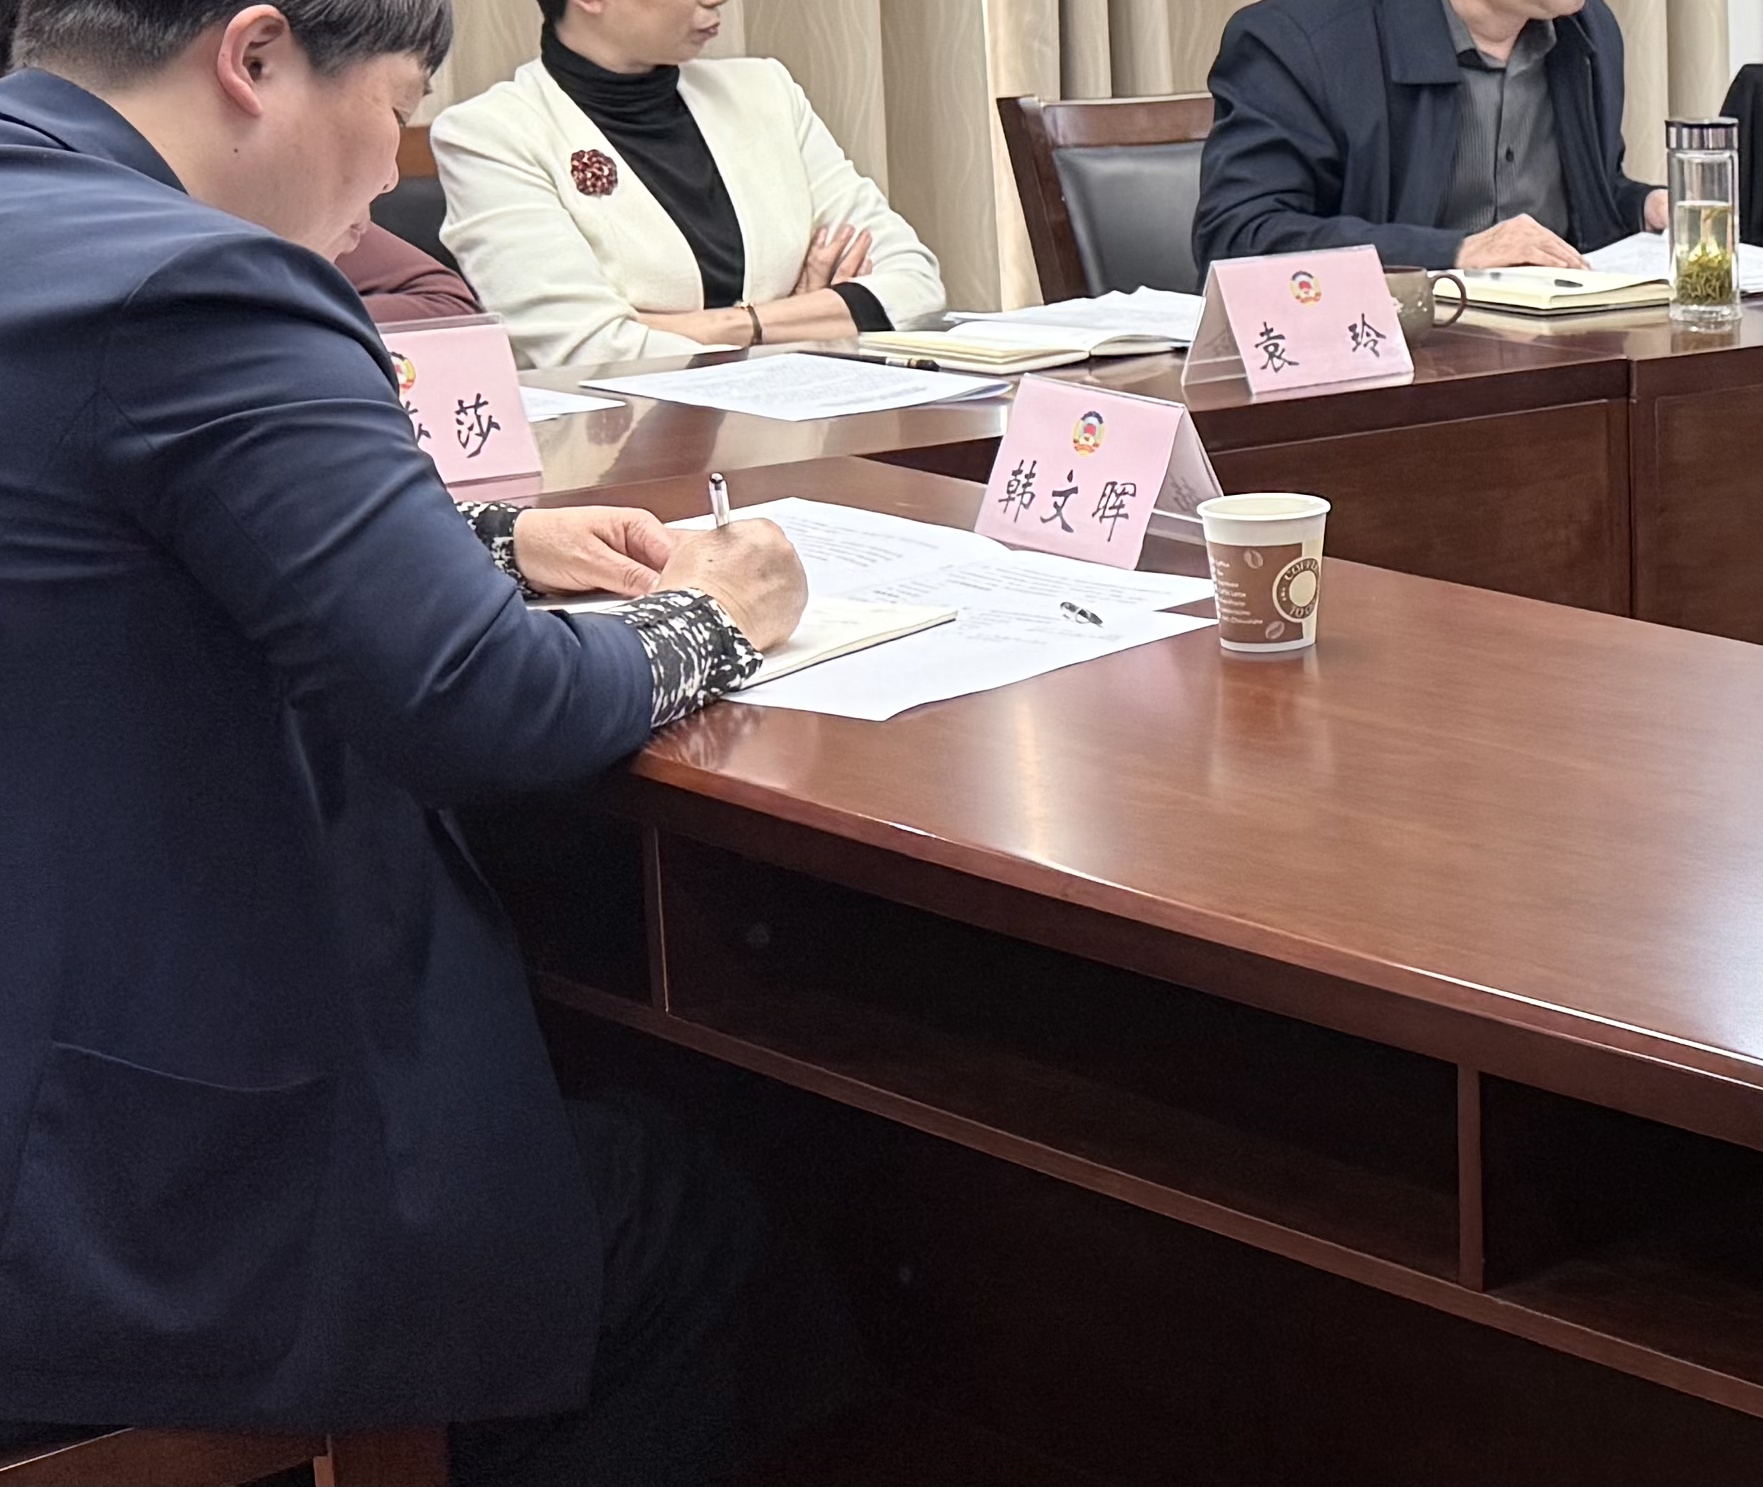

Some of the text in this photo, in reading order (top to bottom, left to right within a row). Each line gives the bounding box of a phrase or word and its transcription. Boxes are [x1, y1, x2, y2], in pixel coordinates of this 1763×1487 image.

[1254, 312, 1388, 373] 袁玲
[998, 458, 1138, 543] 韩文晖
